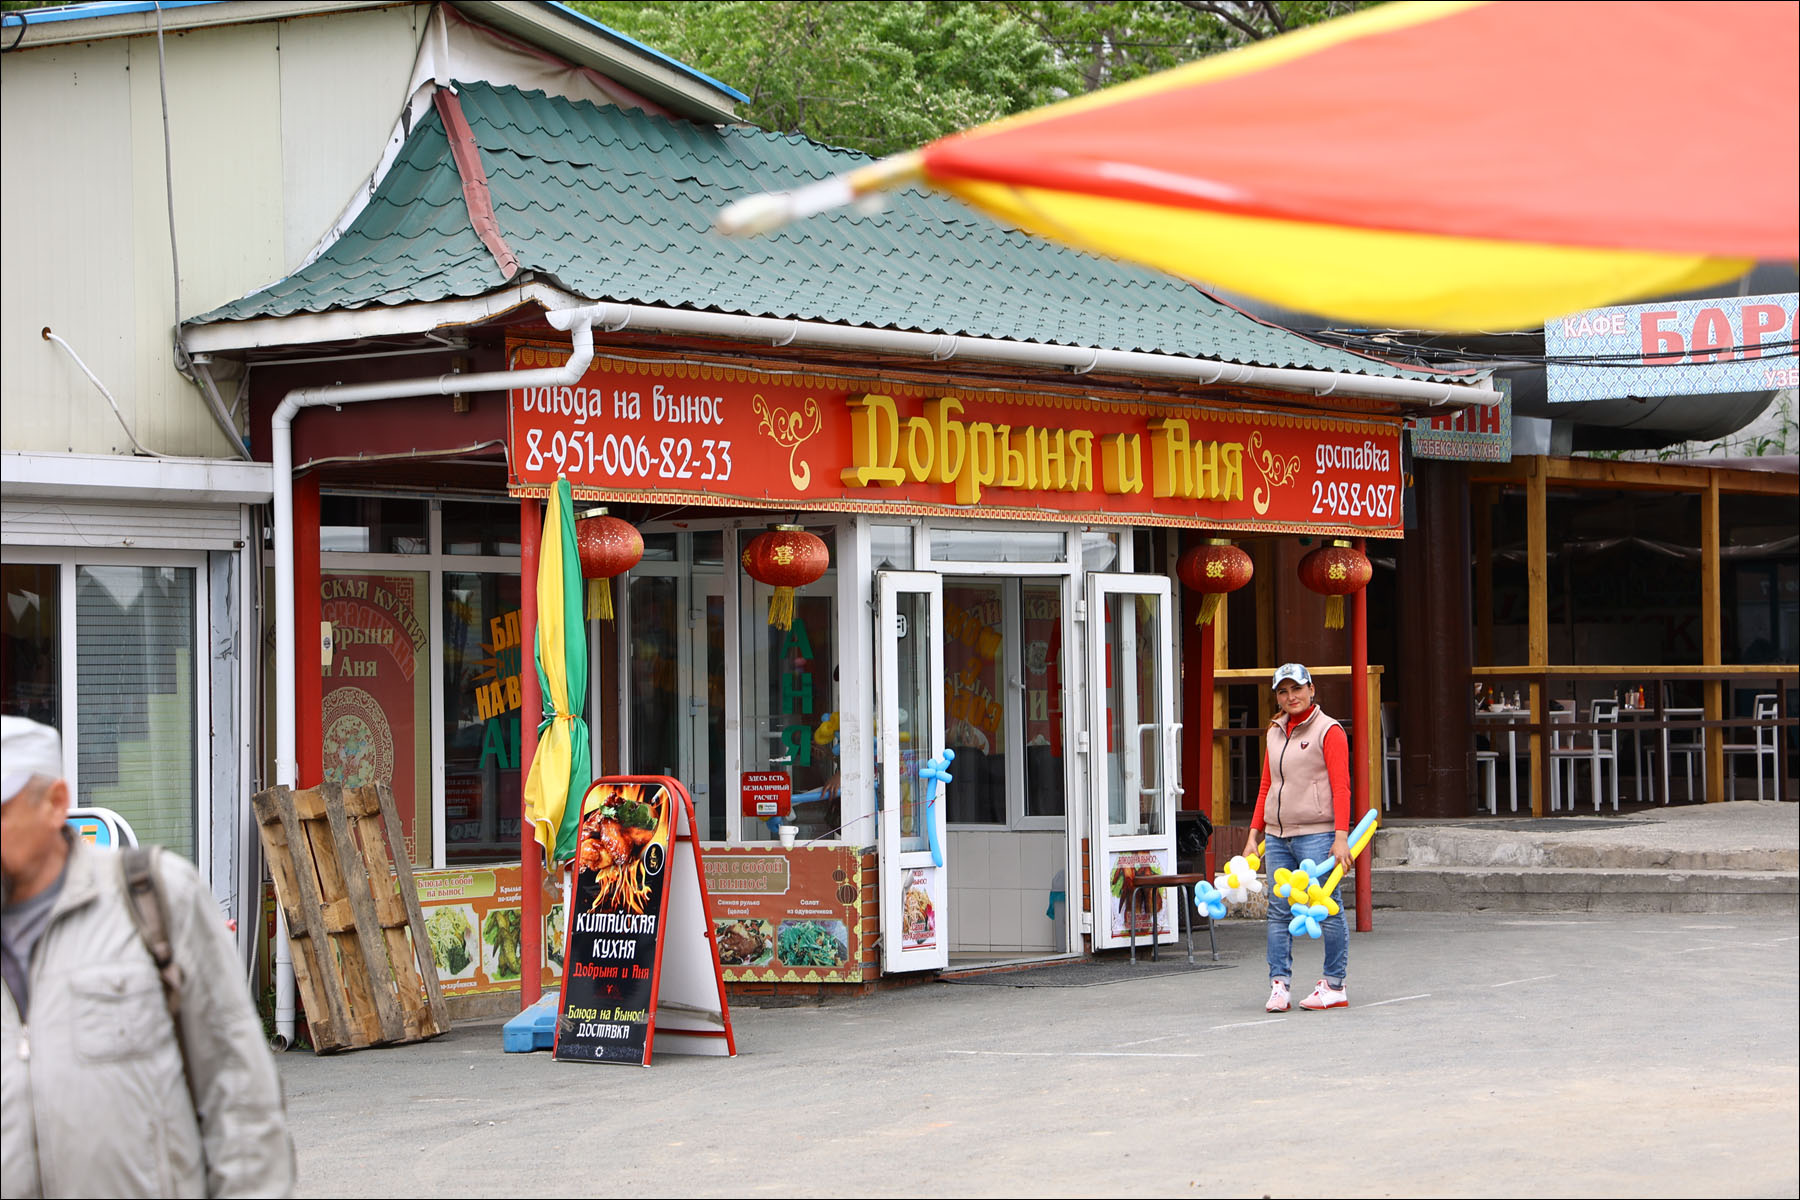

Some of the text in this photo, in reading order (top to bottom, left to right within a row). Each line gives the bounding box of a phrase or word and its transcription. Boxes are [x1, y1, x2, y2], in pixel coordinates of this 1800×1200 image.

[1563, 313, 1627, 338] КАФЕ
[1640, 303, 1799, 366] БАР
[613, 390, 641, 421] на
[652, 384, 724, 425] вынос
[525, 428, 732, 481] 8-951-006-82-33
[848, 392, 1245, 504] Добрыня и Аня
[1315, 440, 1390, 475] доставка
[1416, 439, 1501, 459] УЗБЕКСКАЯ КУХНЯ
[1311, 480, 1396, 519] 2-988-087
[320, 579, 369, 600] СКАЯ
[373, 585, 428, 653] КУХНЯ
[331, 620, 394, 650] брыня
[490, 609, 521, 651] БЛ
[339, 656, 377, 677] Аня
[495, 649, 521, 681] СКИ
[476, 672, 521, 721] НА В
[703, 858, 784, 876] юда с собой
[417, 874, 474, 889] Блюда с собой
[426, 886, 465, 898] на вынос!
[718, 875, 768, 890] вынос!
[576, 910, 656, 934] КИТАЙСКАЯ
[592, 938, 637, 960] КУХНЯ
[573, 962, 650, 981] Добрыня и Аня
[567, 1004, 645, 1023] Блюда на вынос!
[576, 1023, 631, 1040] ДОСТАВКА
